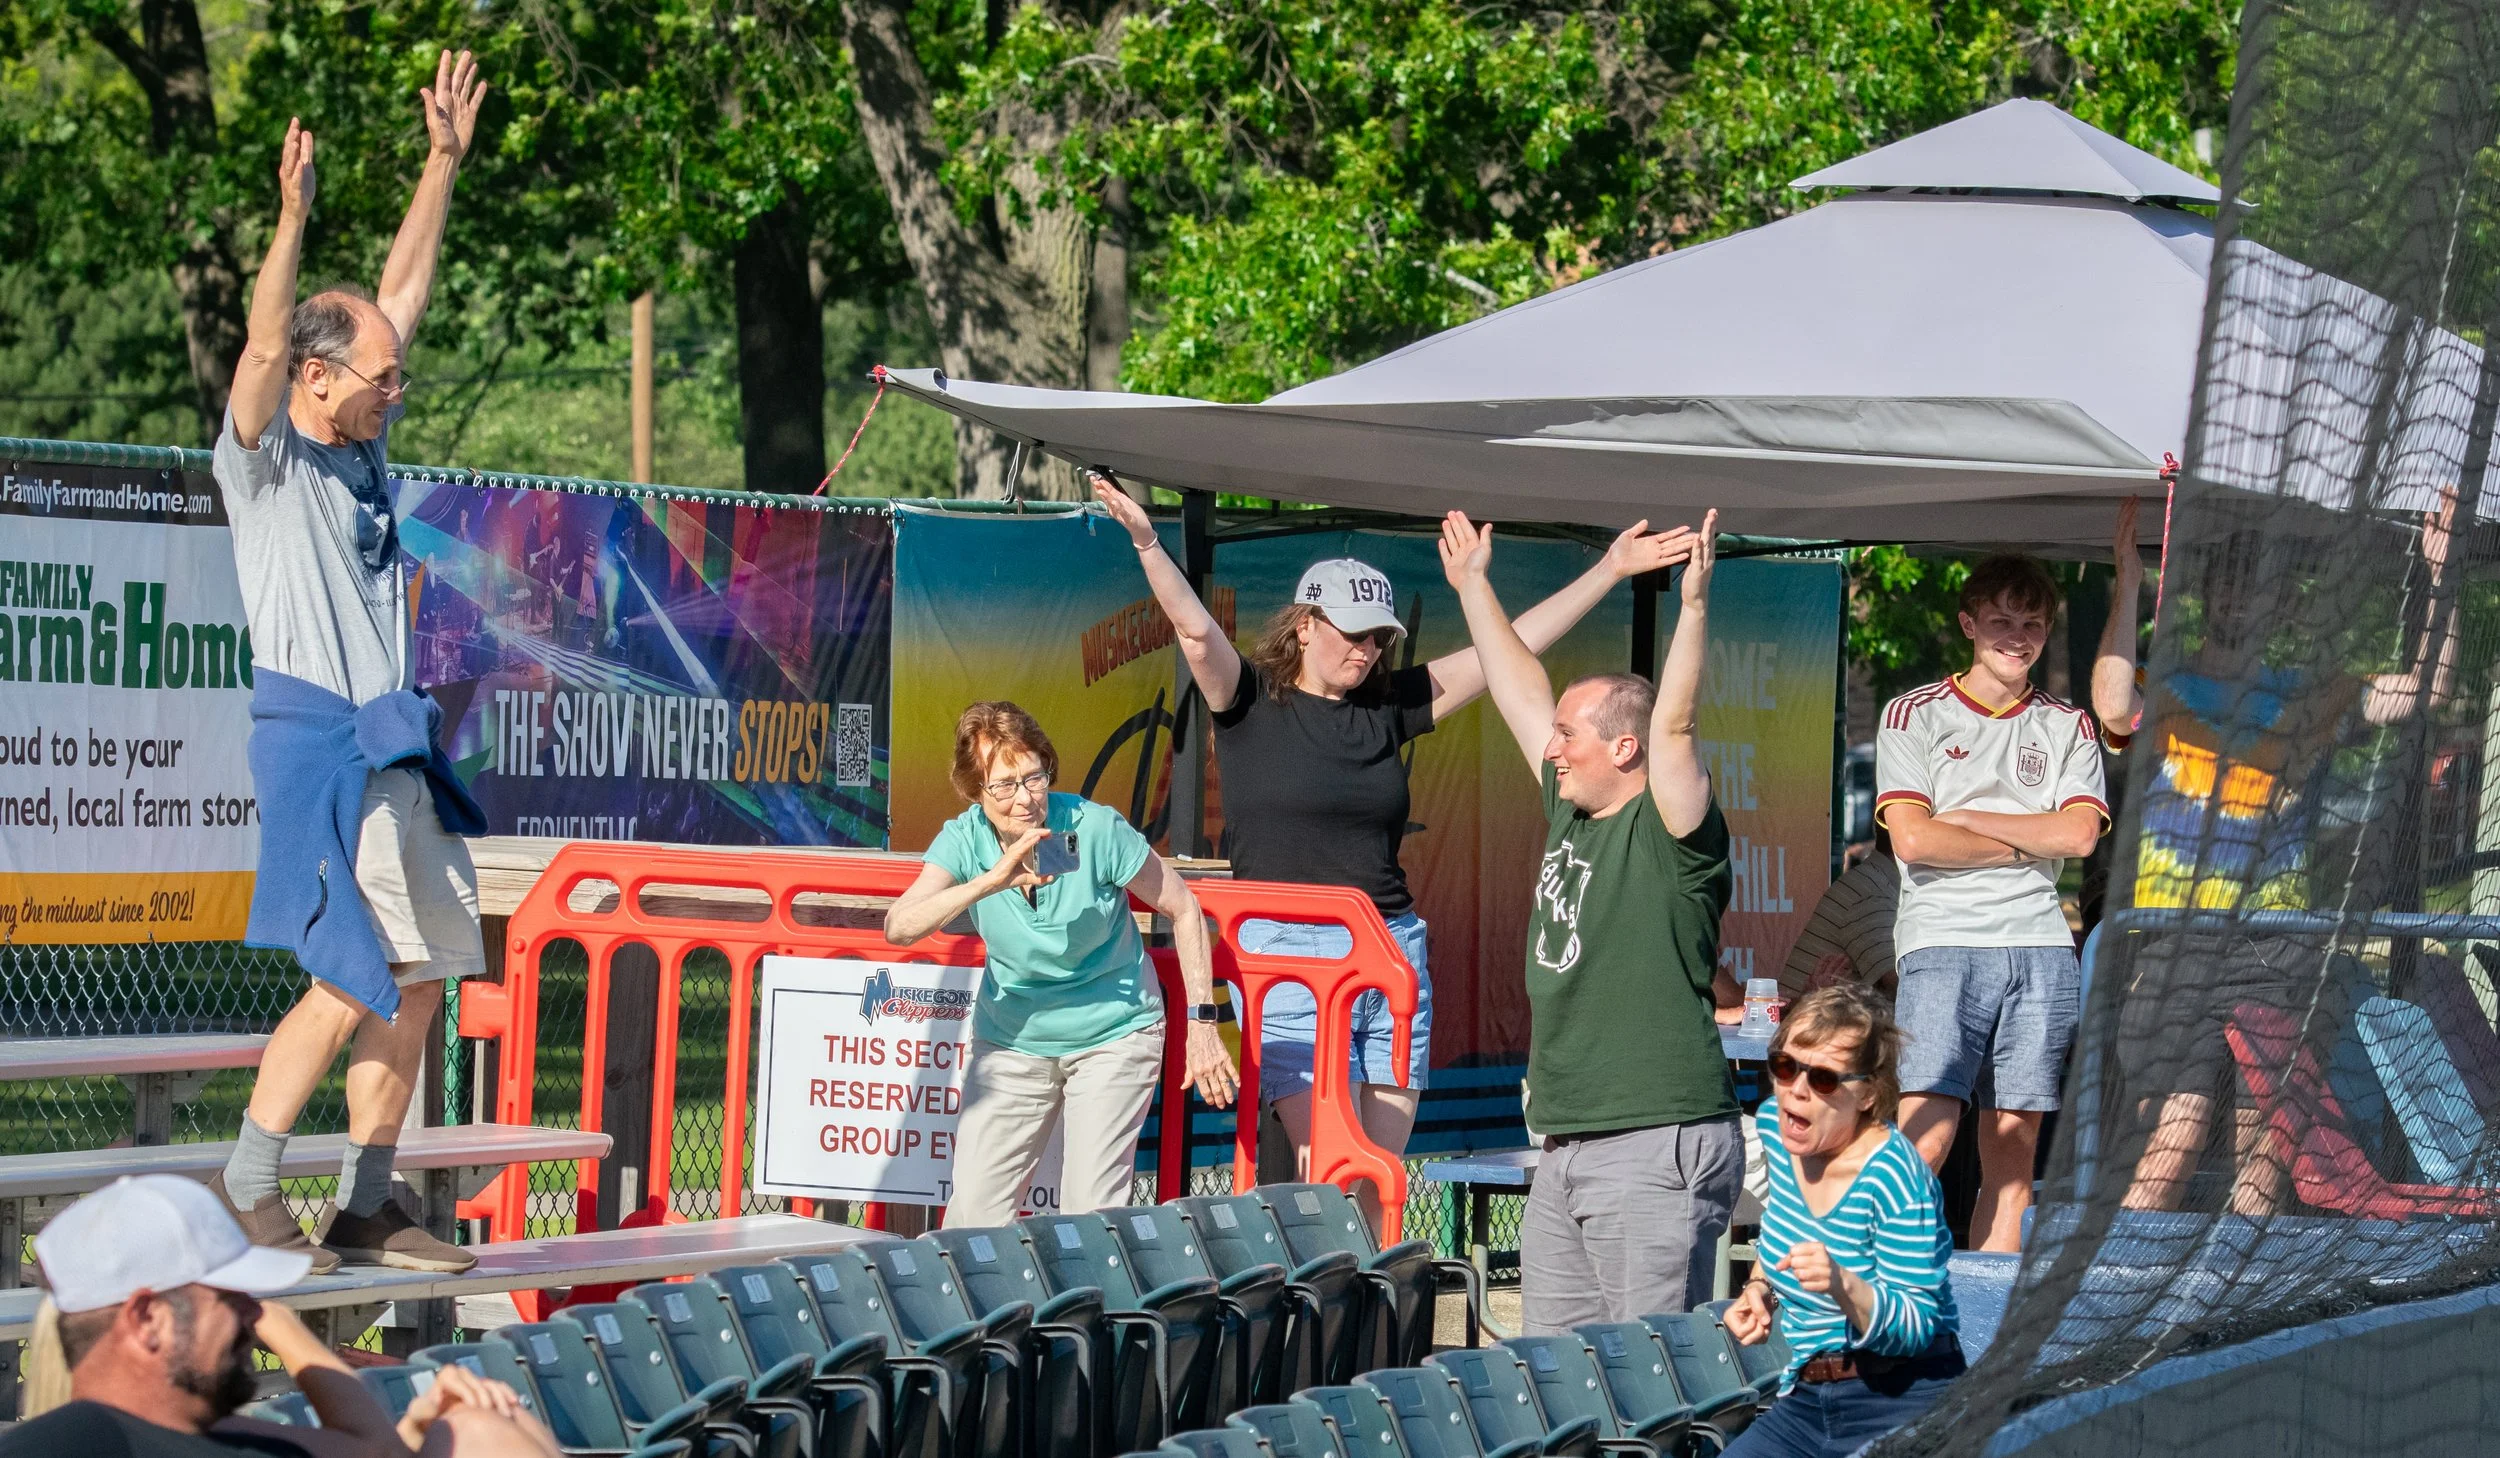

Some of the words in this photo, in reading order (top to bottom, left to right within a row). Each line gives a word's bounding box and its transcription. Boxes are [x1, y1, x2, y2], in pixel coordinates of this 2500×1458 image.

[0, 560, 94, 611] FAMILY
[1349, 578, 1392, 608] 1972
[51, 731, 78, 767] to
[88, 728, 117, 767] be
[125, 738, 183, 780] your
[496, 689, 545, 776] THE
[642, 694, 730, 781] NEVER
[734, 699, 830, 784] STOPS!
[0, 787, 58, 834] ned,
[68, 787, 124, 827] local
[133, 788, 191, 828] farm
[202, 792, 261, 827] stor
[1729, 835, 1793, 913] HILL
[21, 896, 43, 923] the
[46, 896, 107, 923] midwest
[109, 896, 144, 923] since
[150, 888, 195, 922] 2002!
[860, 968, 973, 1026] MUSKEGON
[881, 998, 971, 1023] Clippers
[823, 1034, 886, 1066] THIS
[895, 1038, 965, 1071] SECT
[809, 1078, 961, 1116] RESERVED
[819, 1124, 922, 1158] GROUP
